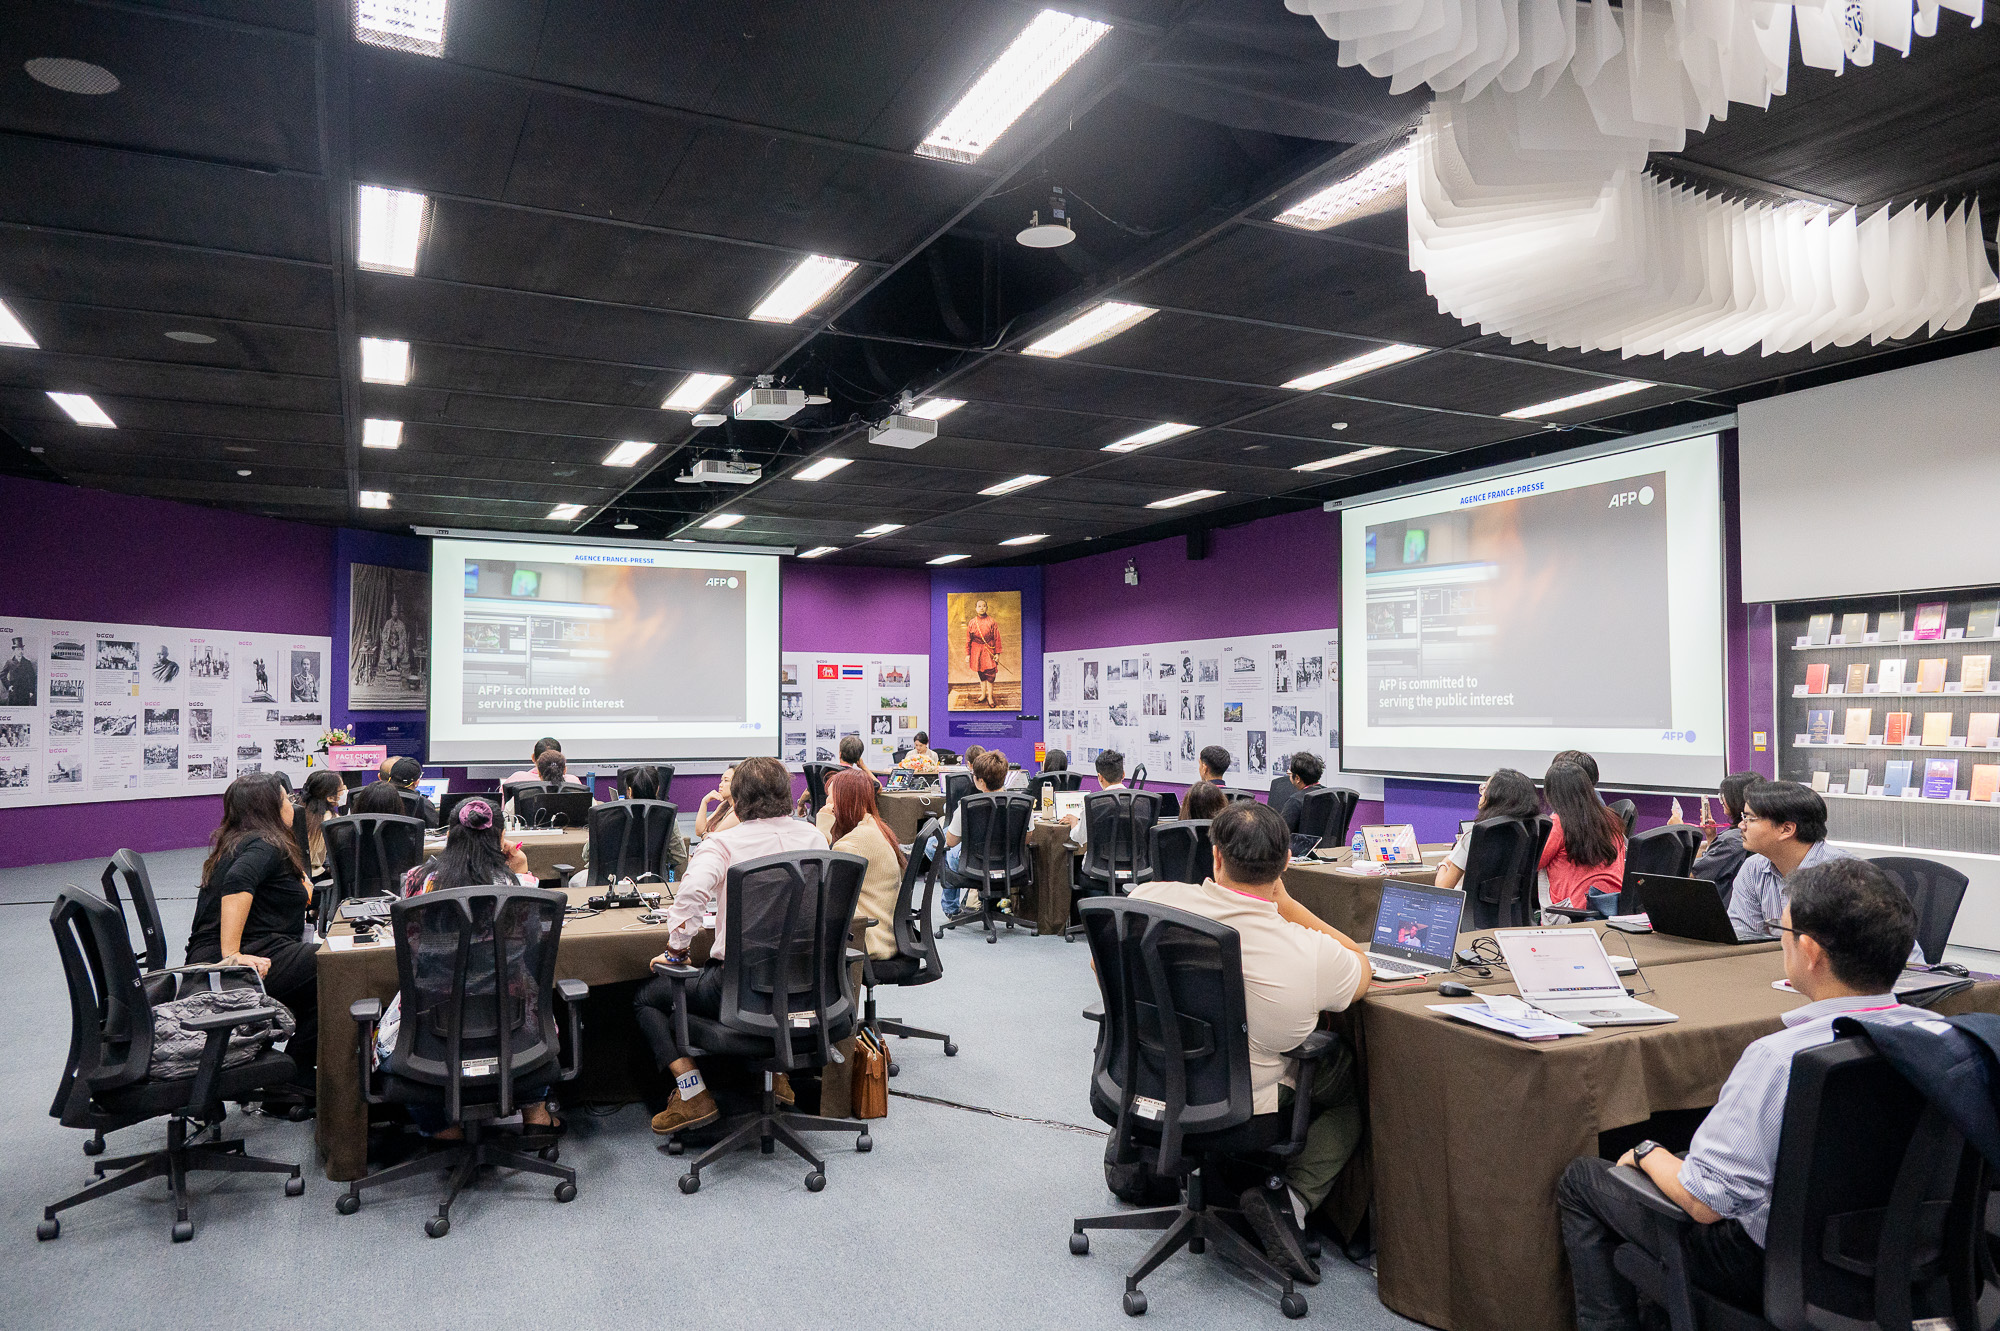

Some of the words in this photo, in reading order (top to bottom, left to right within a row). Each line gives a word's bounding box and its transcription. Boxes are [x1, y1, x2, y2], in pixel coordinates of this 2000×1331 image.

[1460, 493, 1486, 505] AGENCE
[1487, 481, 1545, 499] FRANCE-PRESSE
[1608, 491, 1638, 509] AFP
[602, 556, 655, 564] FRANCE-PRESSE
[705, 577, 727, 587] AFP
[1379, 679, 1396, 691] AFP
[1398, 677, 1407, 690] is
[1409, 675, 1464, 690] committed
[1466, 675, 1478, 688] to
[478, 685, 501, 695] AFP
[503, 685, 513, 695] is
[515, 685, 577, 695] committed
[578, 685, 591, 695] to
[478, 698, 522, 711] serving
[523, 698, 543, 708] the
[545, 698, 580, 711] public
[582, 698, 625, 708] interest
[1379, 694, 1415, 710] serving
[1416, 693, 1433, 707] the
[1435, 692, 1468, 709] public
[1470, 692, 1514, 706] interest
[1662, 731, 1684, 741] AFP
